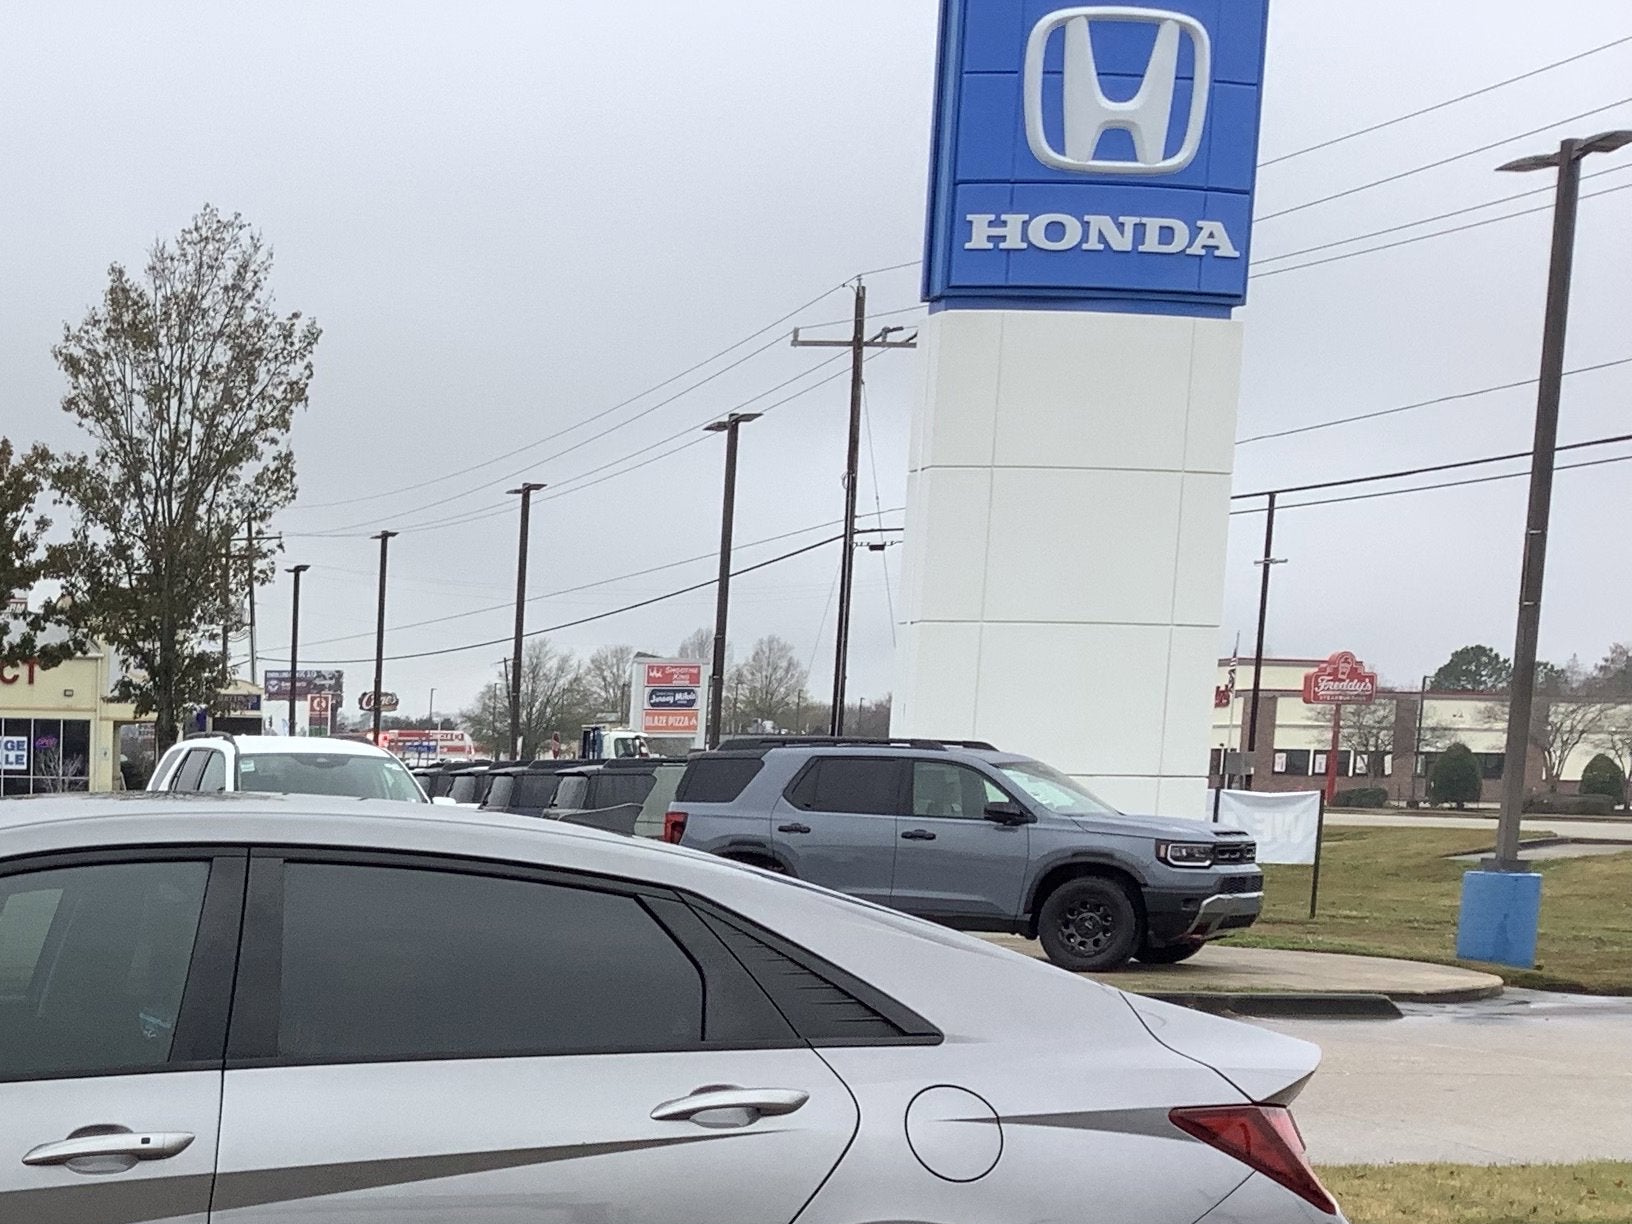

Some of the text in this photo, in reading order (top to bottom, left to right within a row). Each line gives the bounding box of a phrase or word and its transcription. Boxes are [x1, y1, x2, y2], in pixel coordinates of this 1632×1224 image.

[964, 213, 1240, 259] HONDA
[1315, 675, 1373, 693] Freddy's
[668, 715, 689, 727] PIZZA
